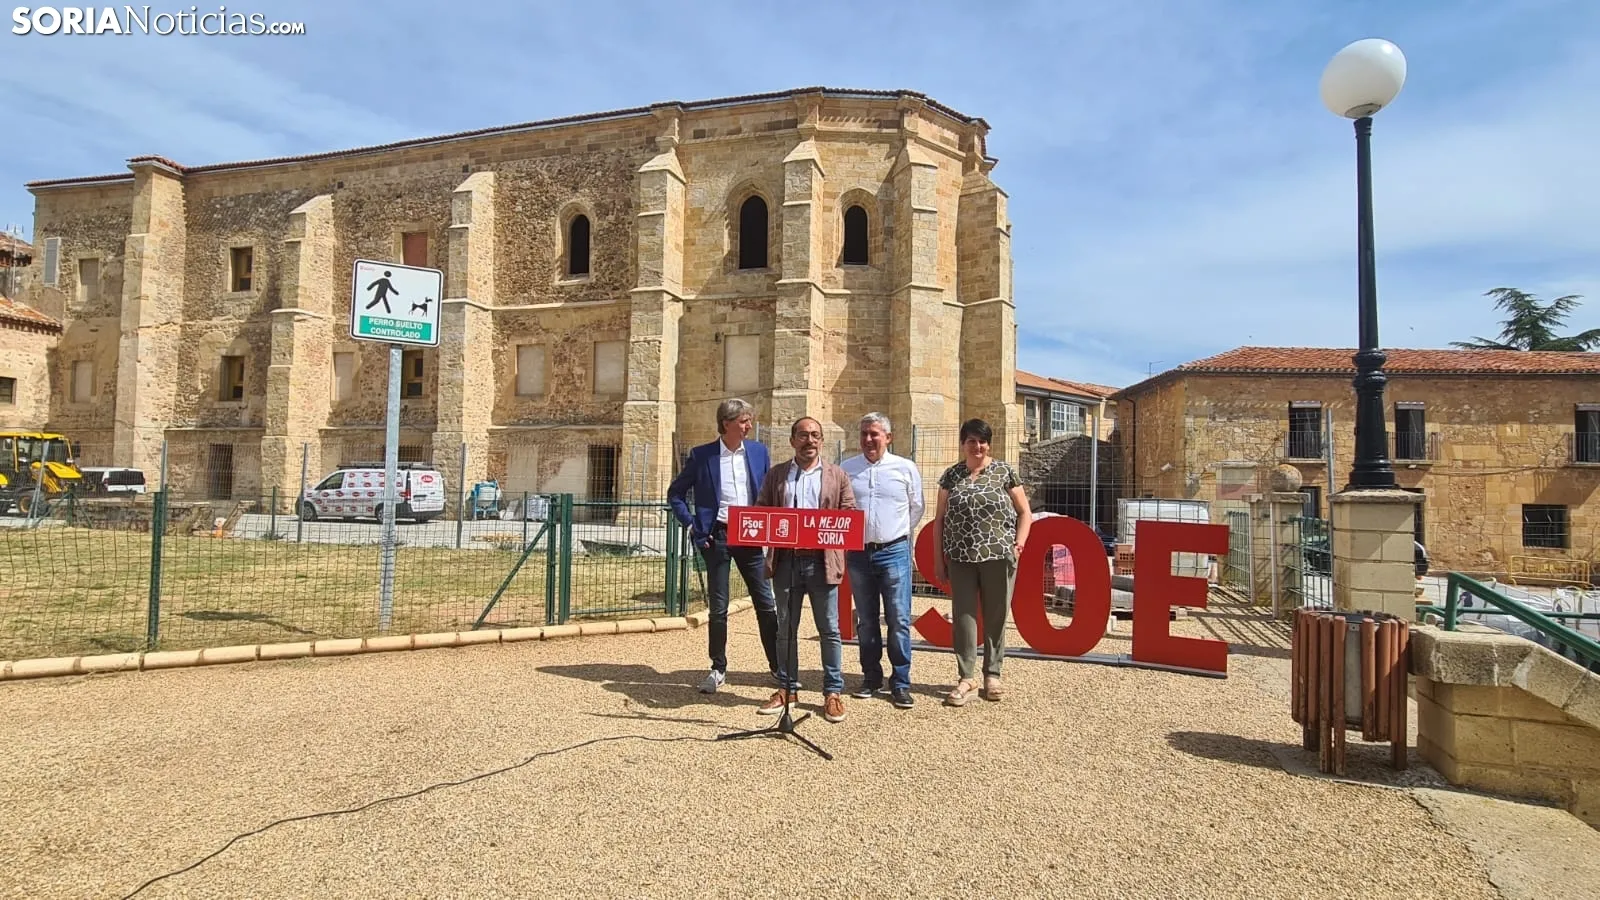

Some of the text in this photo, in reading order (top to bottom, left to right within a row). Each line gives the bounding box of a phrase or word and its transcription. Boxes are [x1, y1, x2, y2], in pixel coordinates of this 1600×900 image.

[368, 317, 423, 329] PERRO SUELTO
[370, 327, 420, 338] CONTROLADO
[742, 519, 764, 529] PSOE
[803, 515, 852, 529] LA MEJOR
[817, 532, 845, 545] SORIA
